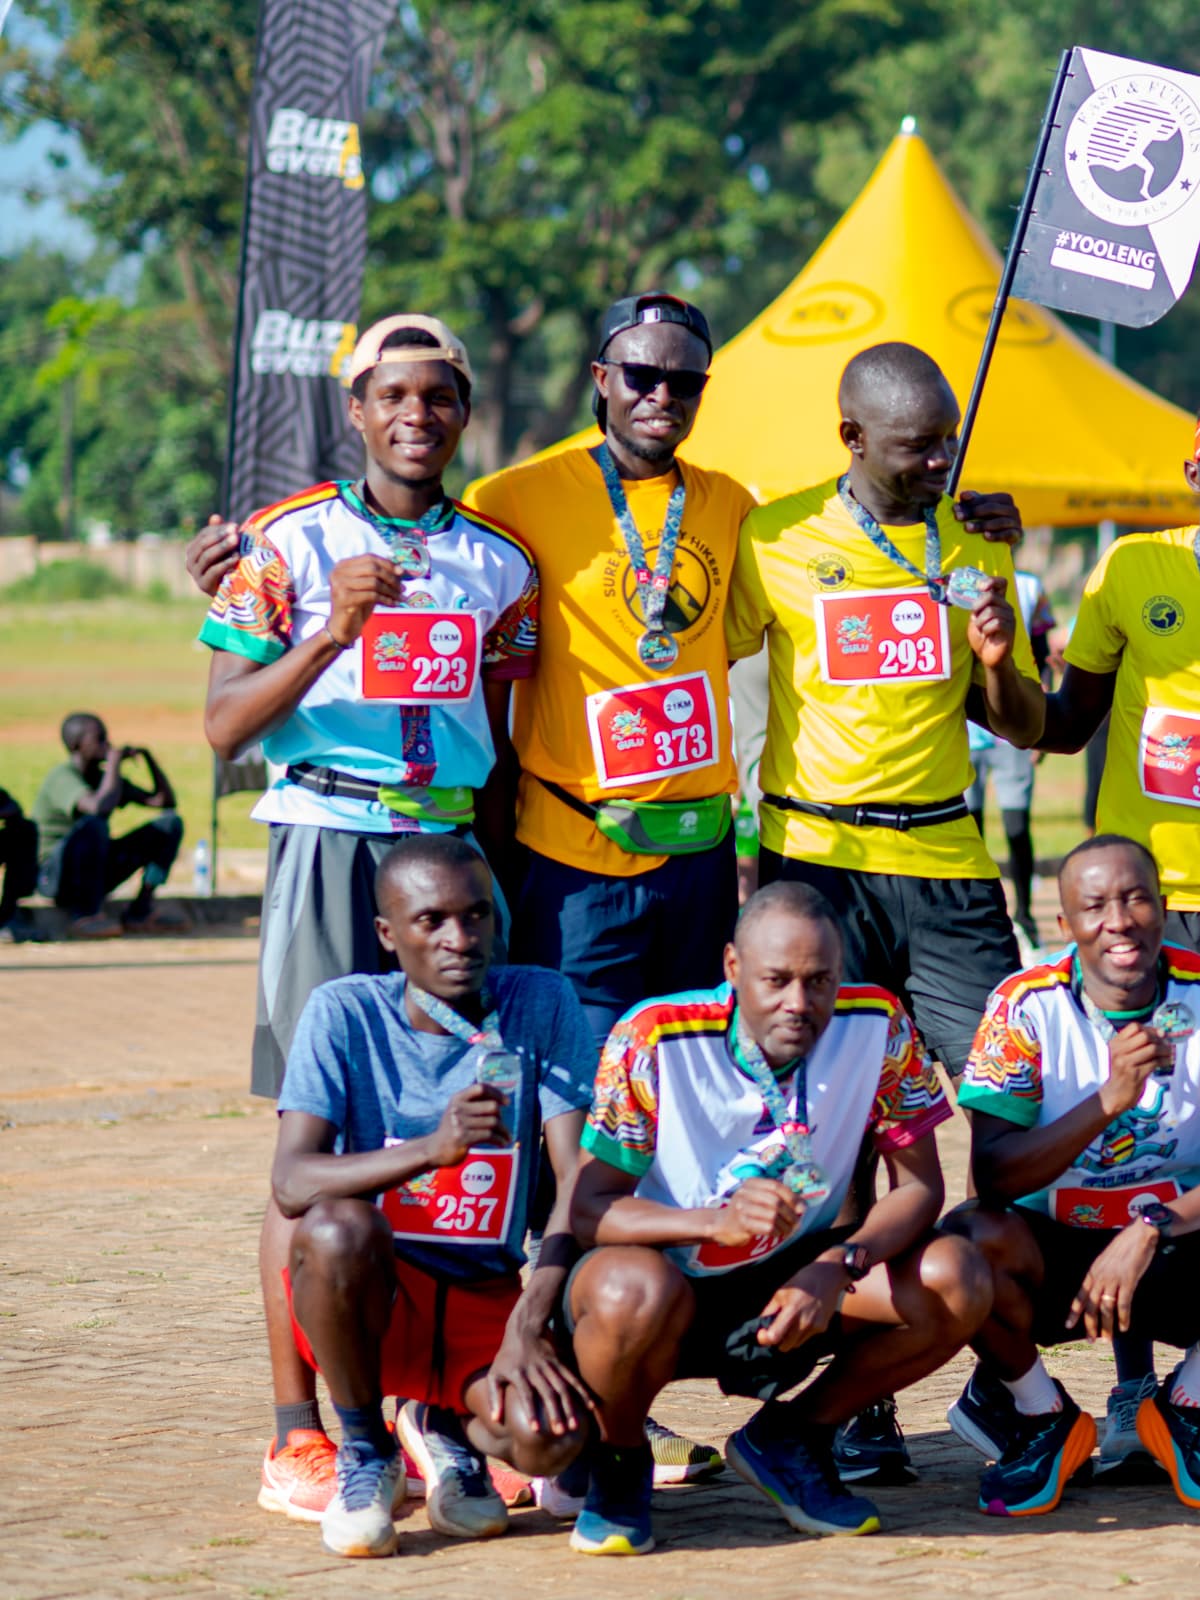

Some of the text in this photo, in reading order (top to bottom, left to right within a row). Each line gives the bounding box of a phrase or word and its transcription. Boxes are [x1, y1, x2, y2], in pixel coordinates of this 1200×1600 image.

[1056, 231, 1155, 270] #YOOLENG
[604, 557, 620, 598] SURE
[690, 535, 721, 587] HIKERS
[895, 613, 922, 623] 21KM
[432, 634, 460, 642] 21KM
[878, 637, 937, 675] 293
[412, 656, 468, 692] 223
[666, 700, 691, 712] 21KM
[654, 724, 707, 766] 373
[433, 1194, 499, 1231] 257
